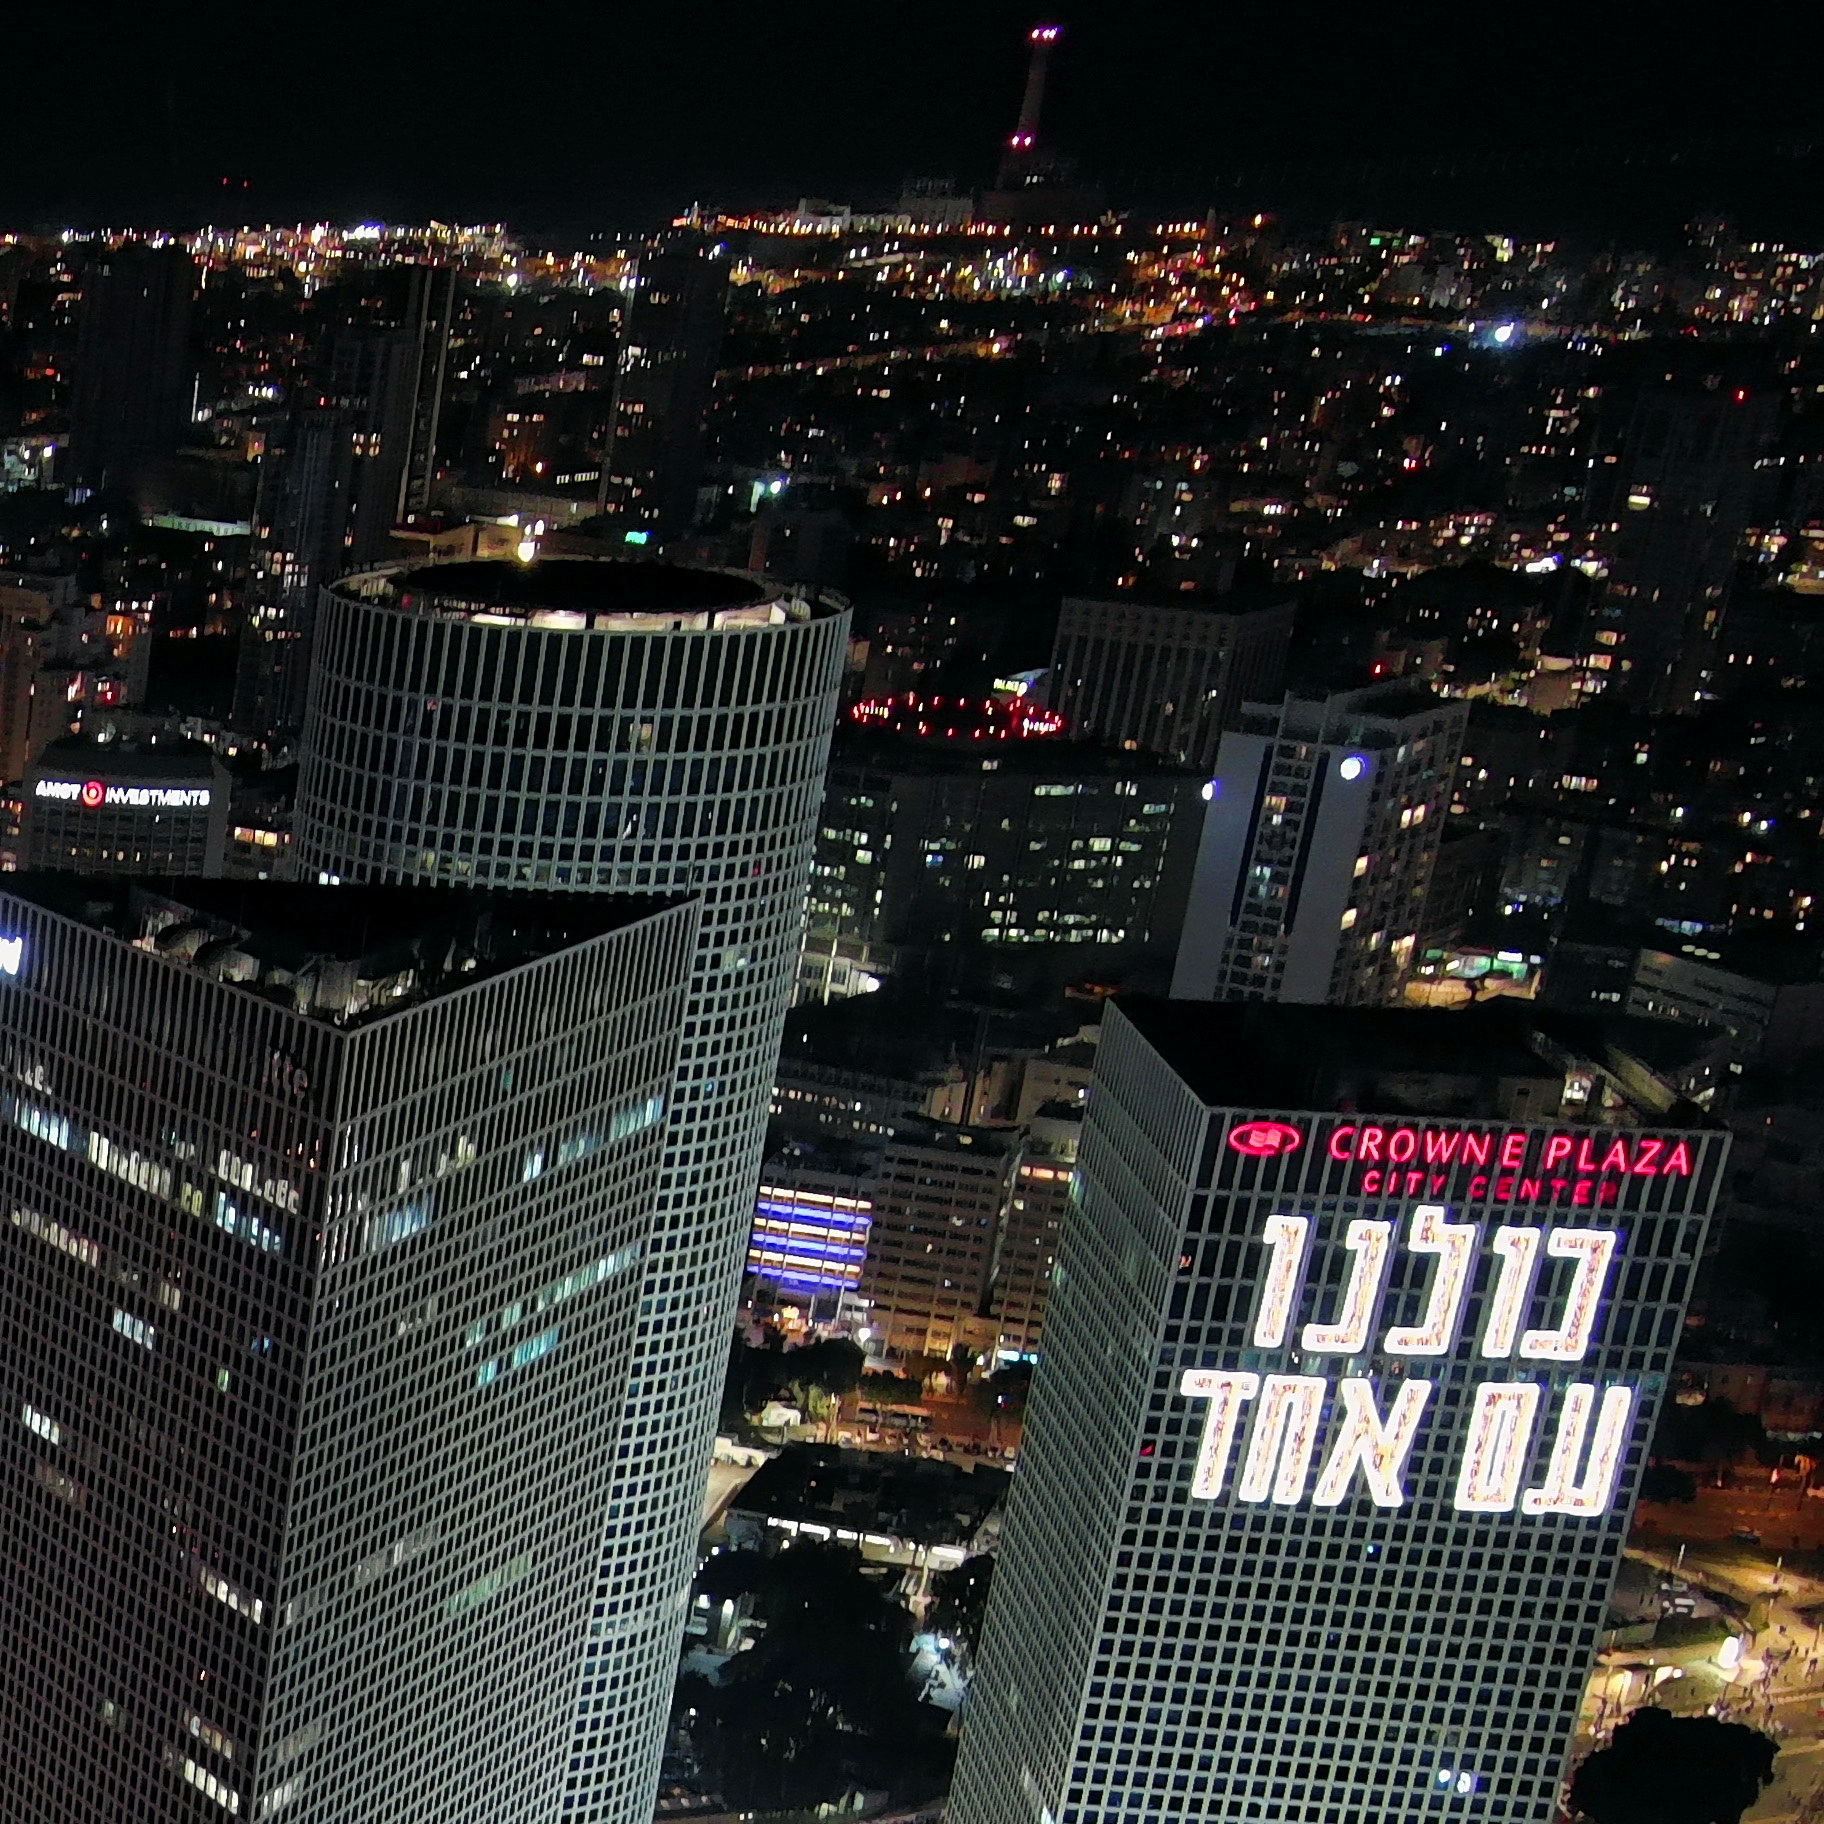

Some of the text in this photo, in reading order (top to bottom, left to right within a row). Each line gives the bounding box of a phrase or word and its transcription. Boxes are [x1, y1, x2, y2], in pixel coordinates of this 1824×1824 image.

[105, 787, 211, 807] INVESTMENTS
[1328, 1127, 1690, 1177] CROWNE PLAZA
[1361, 1169, 1618, 1206] CITY CENTER
[1254, 1206, 1616, 1360] כולנו
[1180, 1368, 1634, 1517] עם אחד
